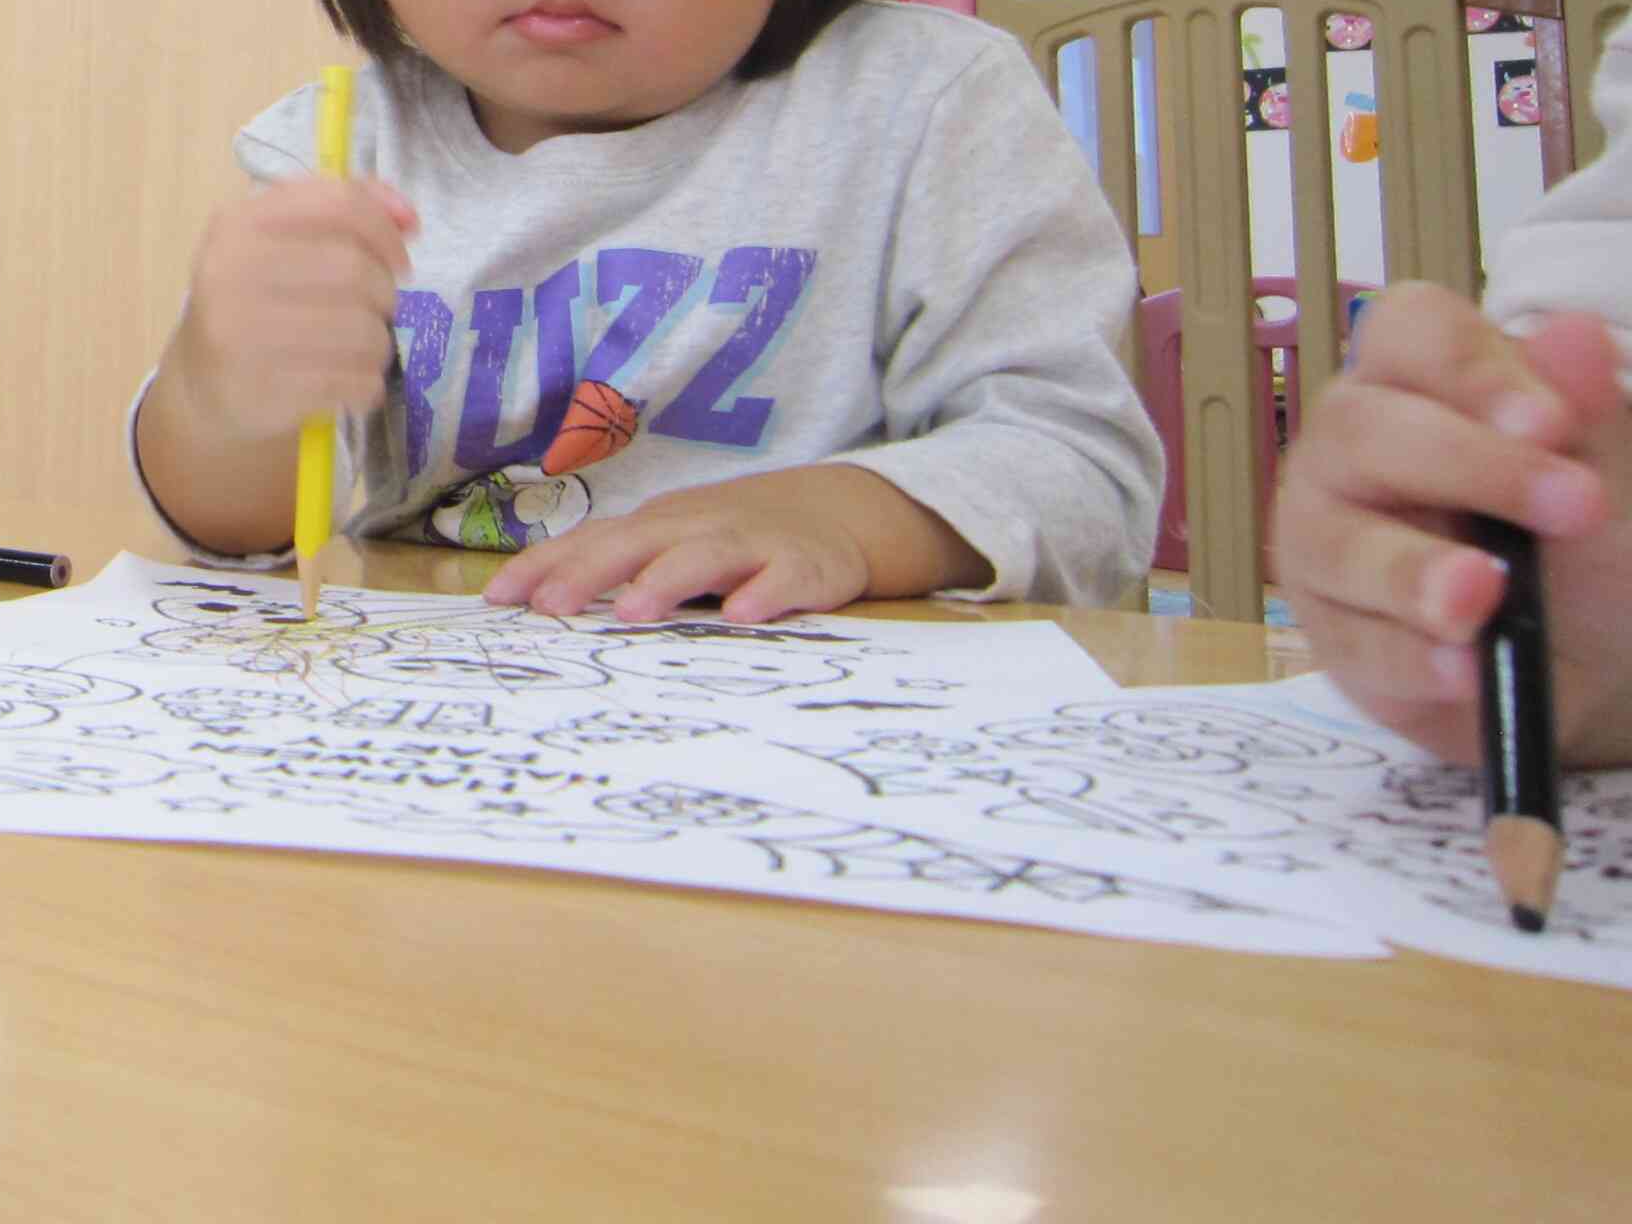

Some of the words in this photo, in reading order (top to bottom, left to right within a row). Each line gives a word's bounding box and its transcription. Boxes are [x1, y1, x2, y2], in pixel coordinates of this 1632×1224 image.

[190, 740, 609, 787] HALLOWEEN
[284, 735, 538, 764] PARTY
[252, 762, 517, 795] HAPPY
